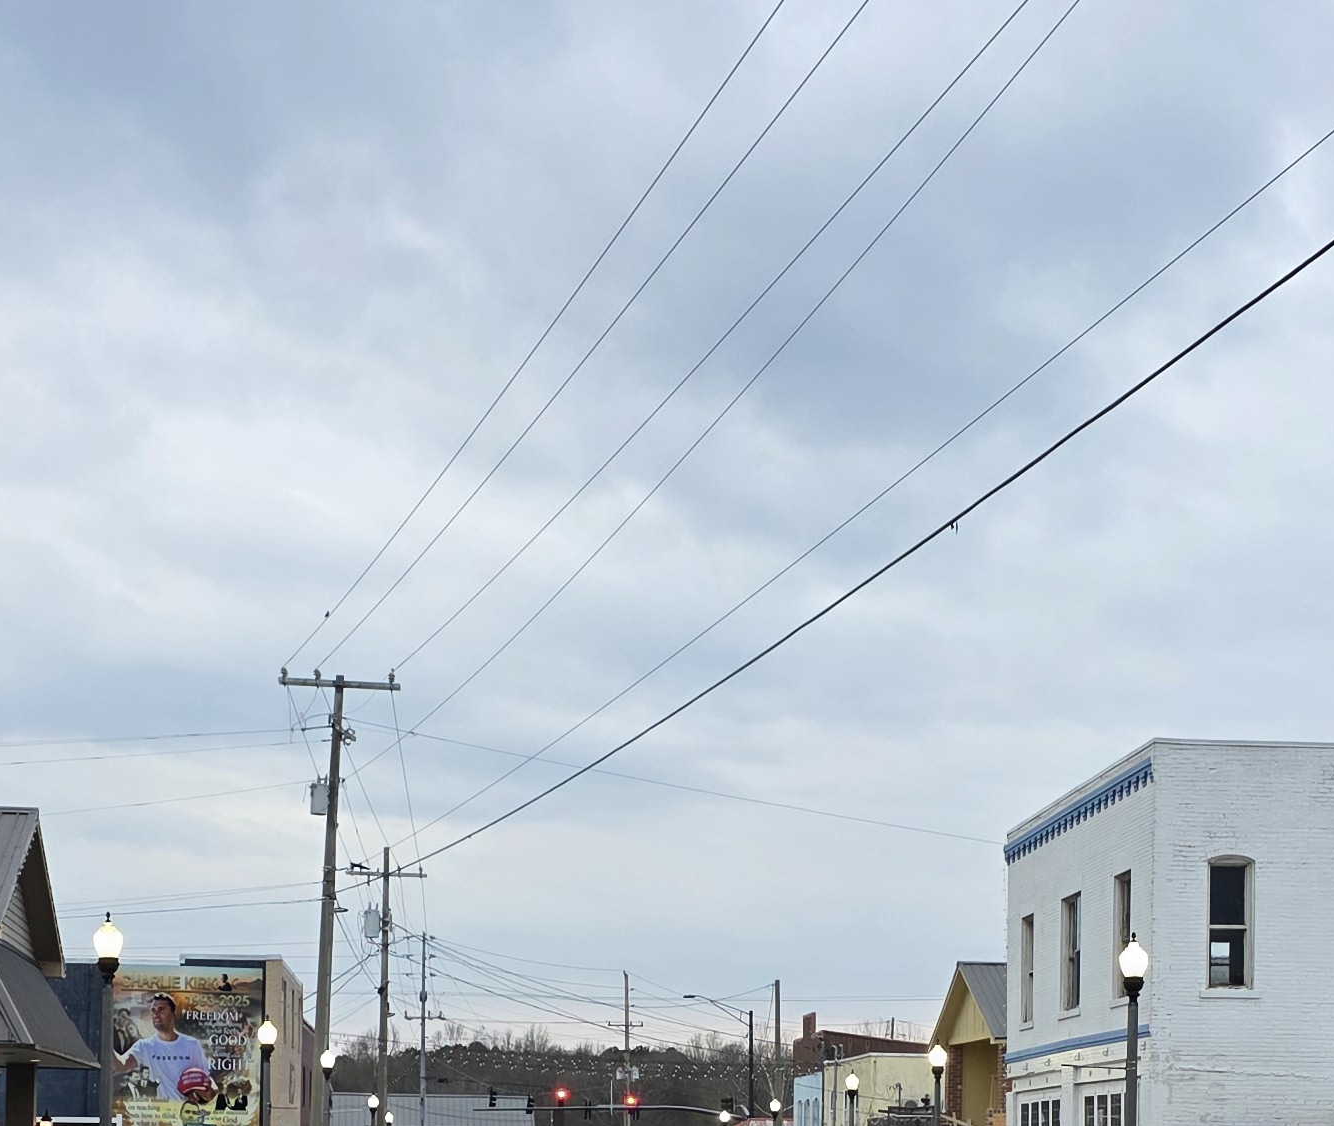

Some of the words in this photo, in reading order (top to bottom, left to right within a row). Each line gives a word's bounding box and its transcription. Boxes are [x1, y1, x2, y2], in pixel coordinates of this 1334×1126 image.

[121, 975, 181, 989] CHARLIE
[185, 976, 217, 990] KIRK
[209, 1034, 247, 1046] GOOD
